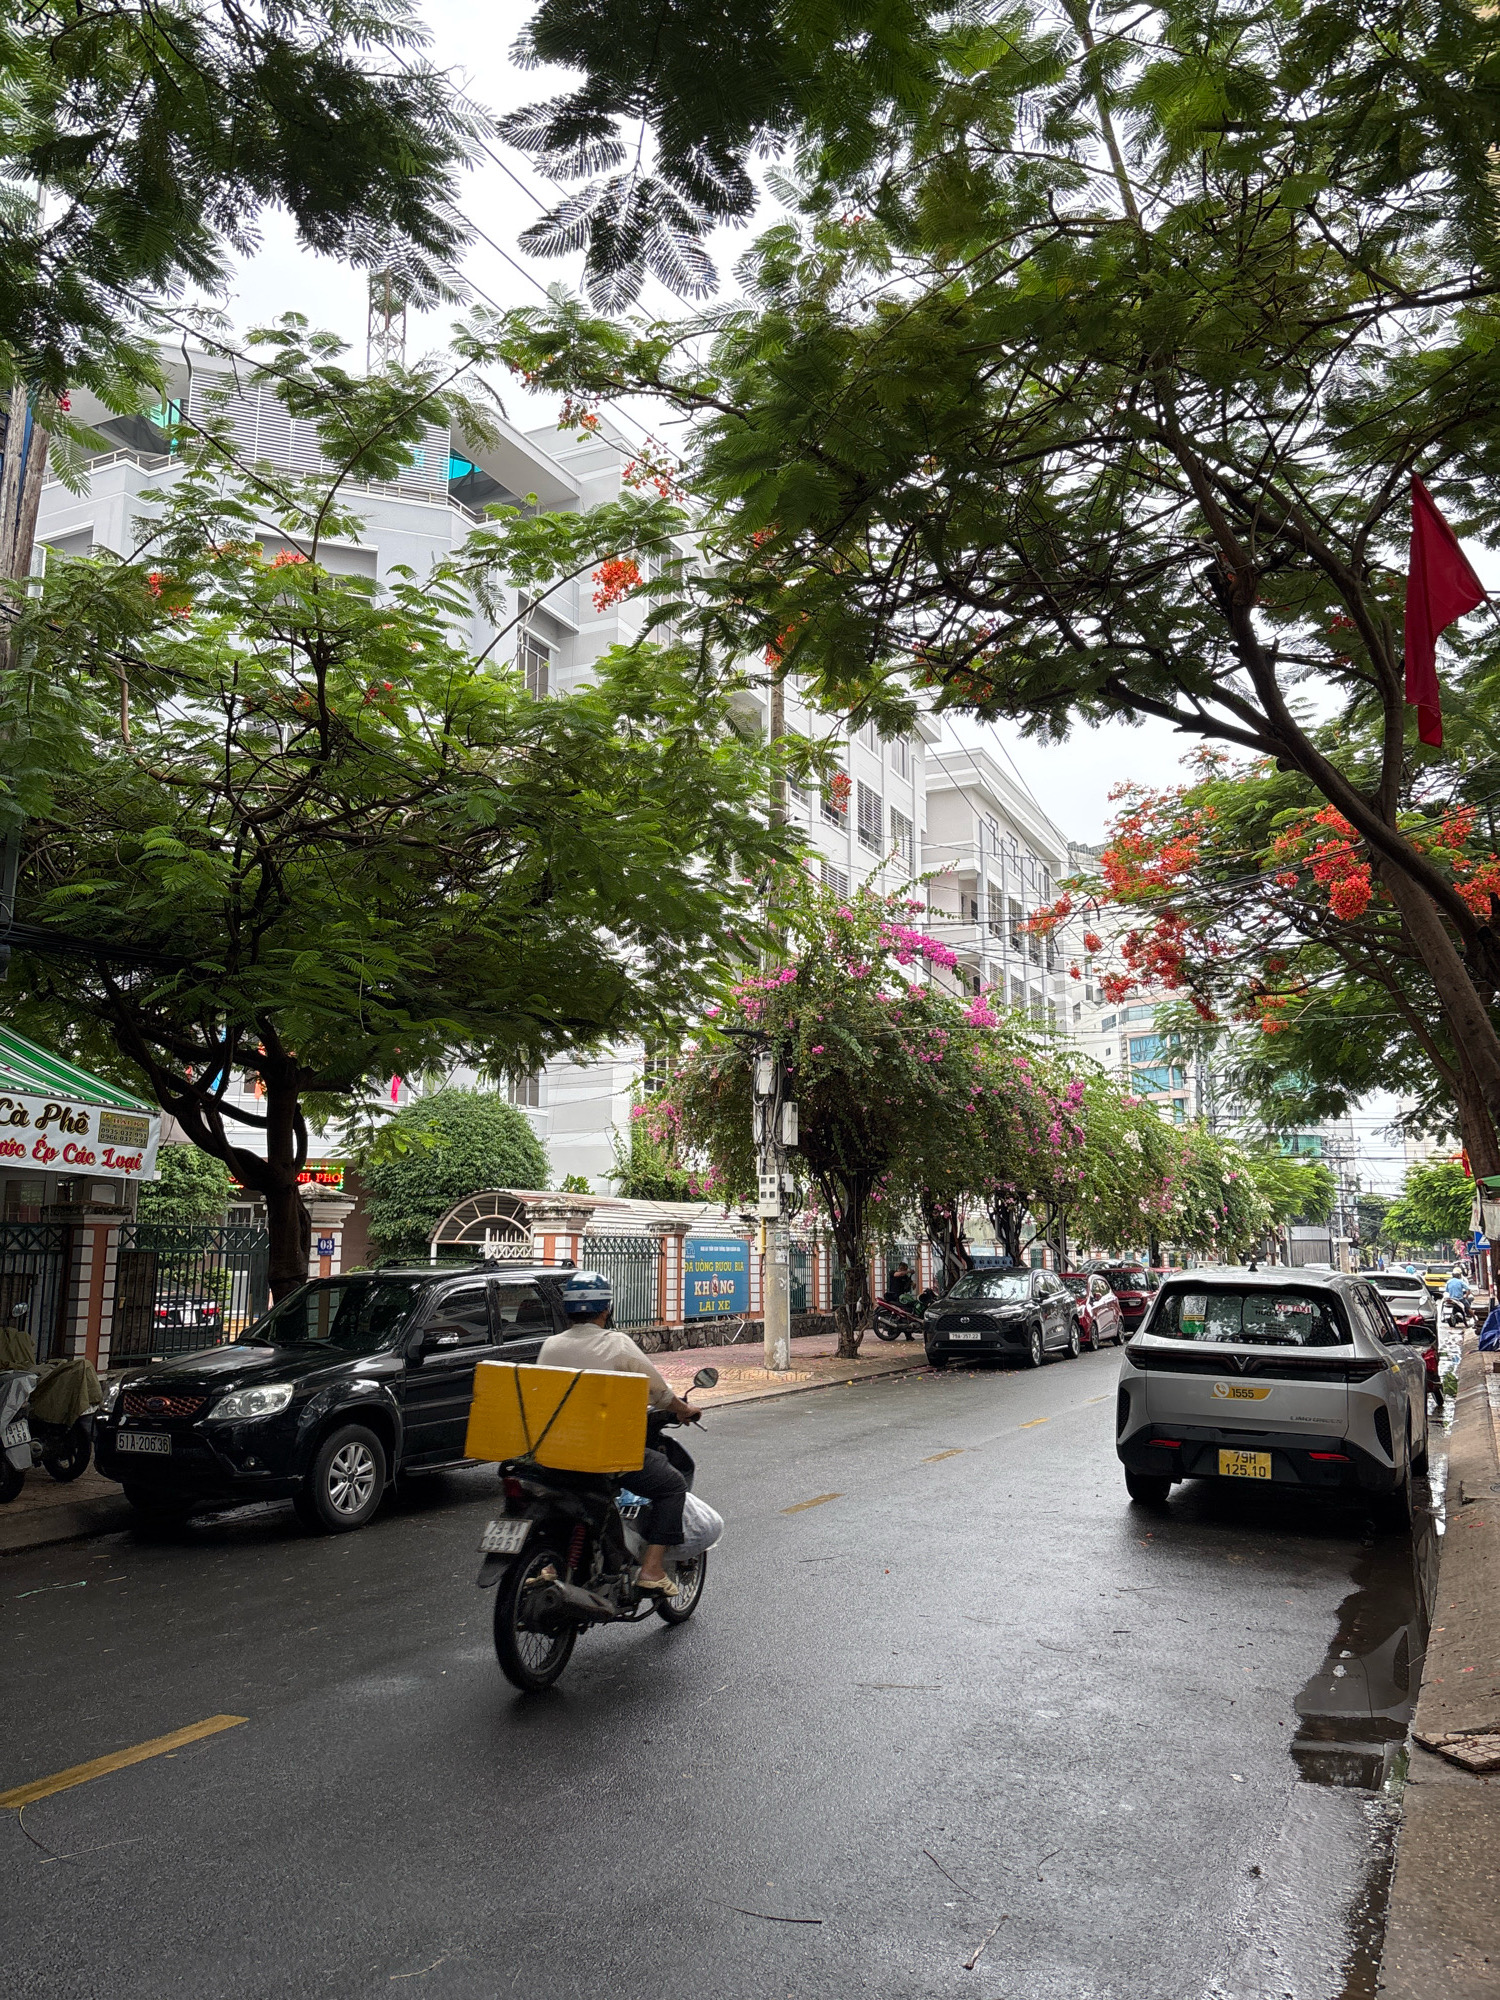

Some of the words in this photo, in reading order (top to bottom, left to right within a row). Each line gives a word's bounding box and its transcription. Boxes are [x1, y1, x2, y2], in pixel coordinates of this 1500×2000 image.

[0, 1098, 31, 1128] Cà
[35, 1103, 91, 1135] Phê
[32, 1133, 60, 1165] Ép
[62, 1142, 96, 1166] Các
[101, 1147, 143, 1175] Loại
[320, 1239, 333, 1250] 03
[717, 1299, 731, 1311] XE
[1291, 1304, 1311, 1314] TAXI
[1231, 1388, 1254, 1399] 1555
[118, 1434, 169, 1452] 51A-206.36
[1233, 1451, 1256, 1464] 79H
[1225, 1463, 1266, 1478] 125.10
